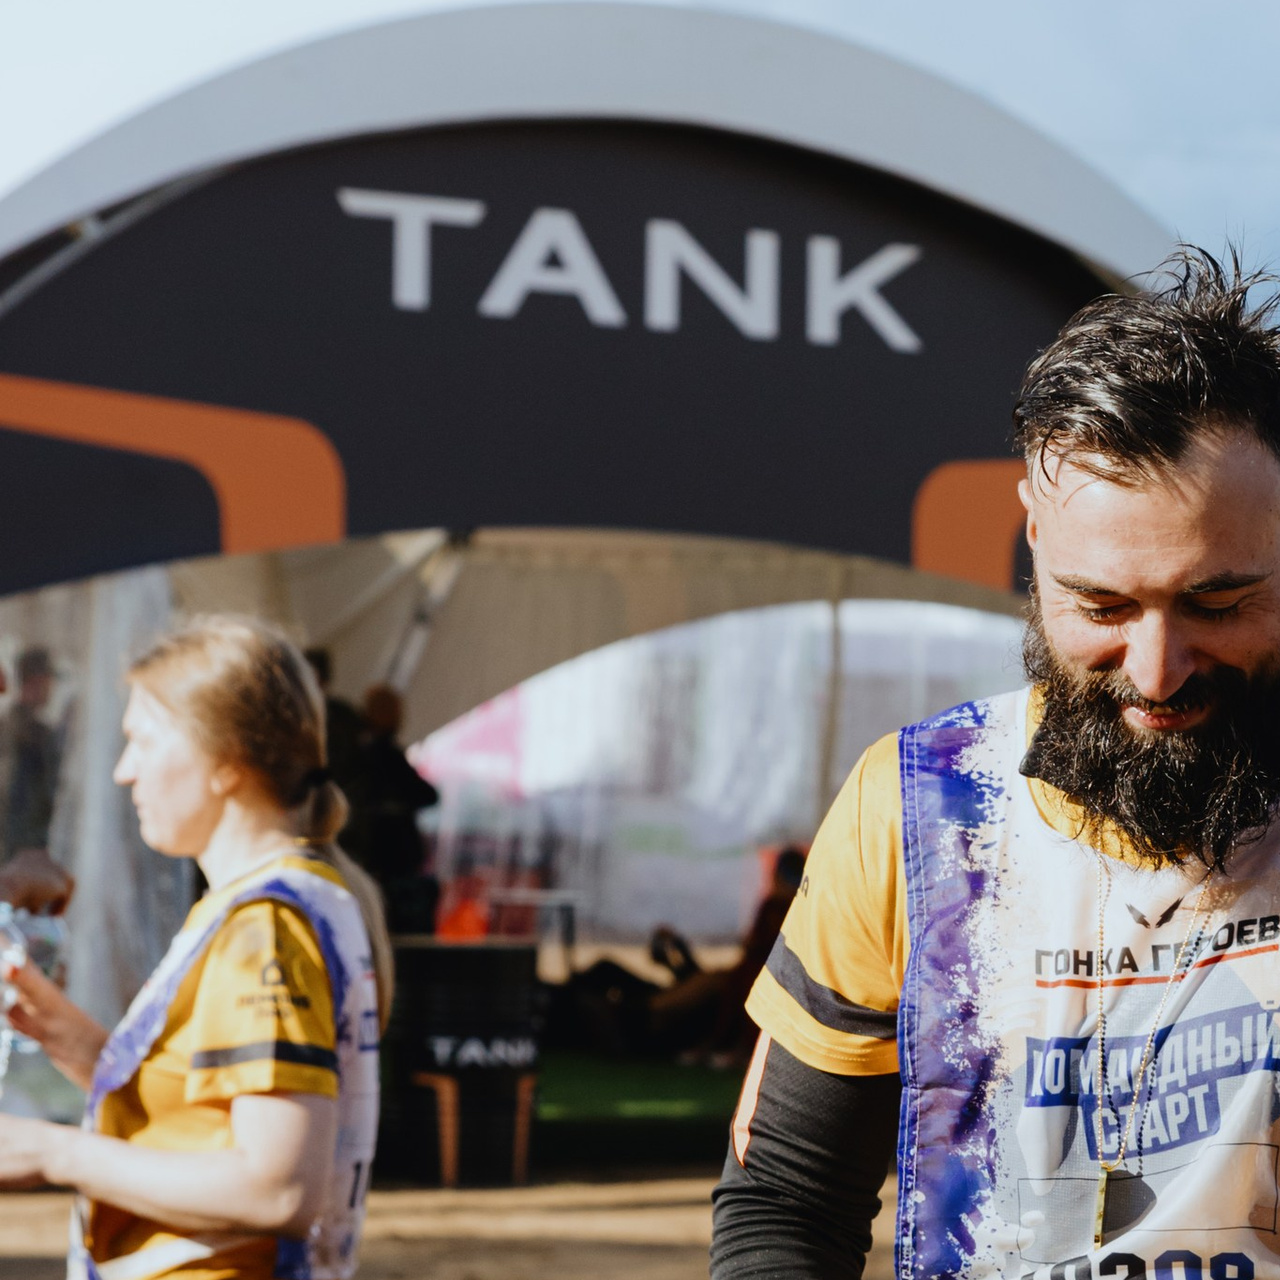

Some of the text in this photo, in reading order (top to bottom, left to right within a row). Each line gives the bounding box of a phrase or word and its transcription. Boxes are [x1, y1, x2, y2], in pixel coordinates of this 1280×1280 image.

[336, 187, 922, 353] TANK
[1035, 946, 1139, 977] ГОНКА
[1092, 1083, 1209, 1154] СТАРТ
